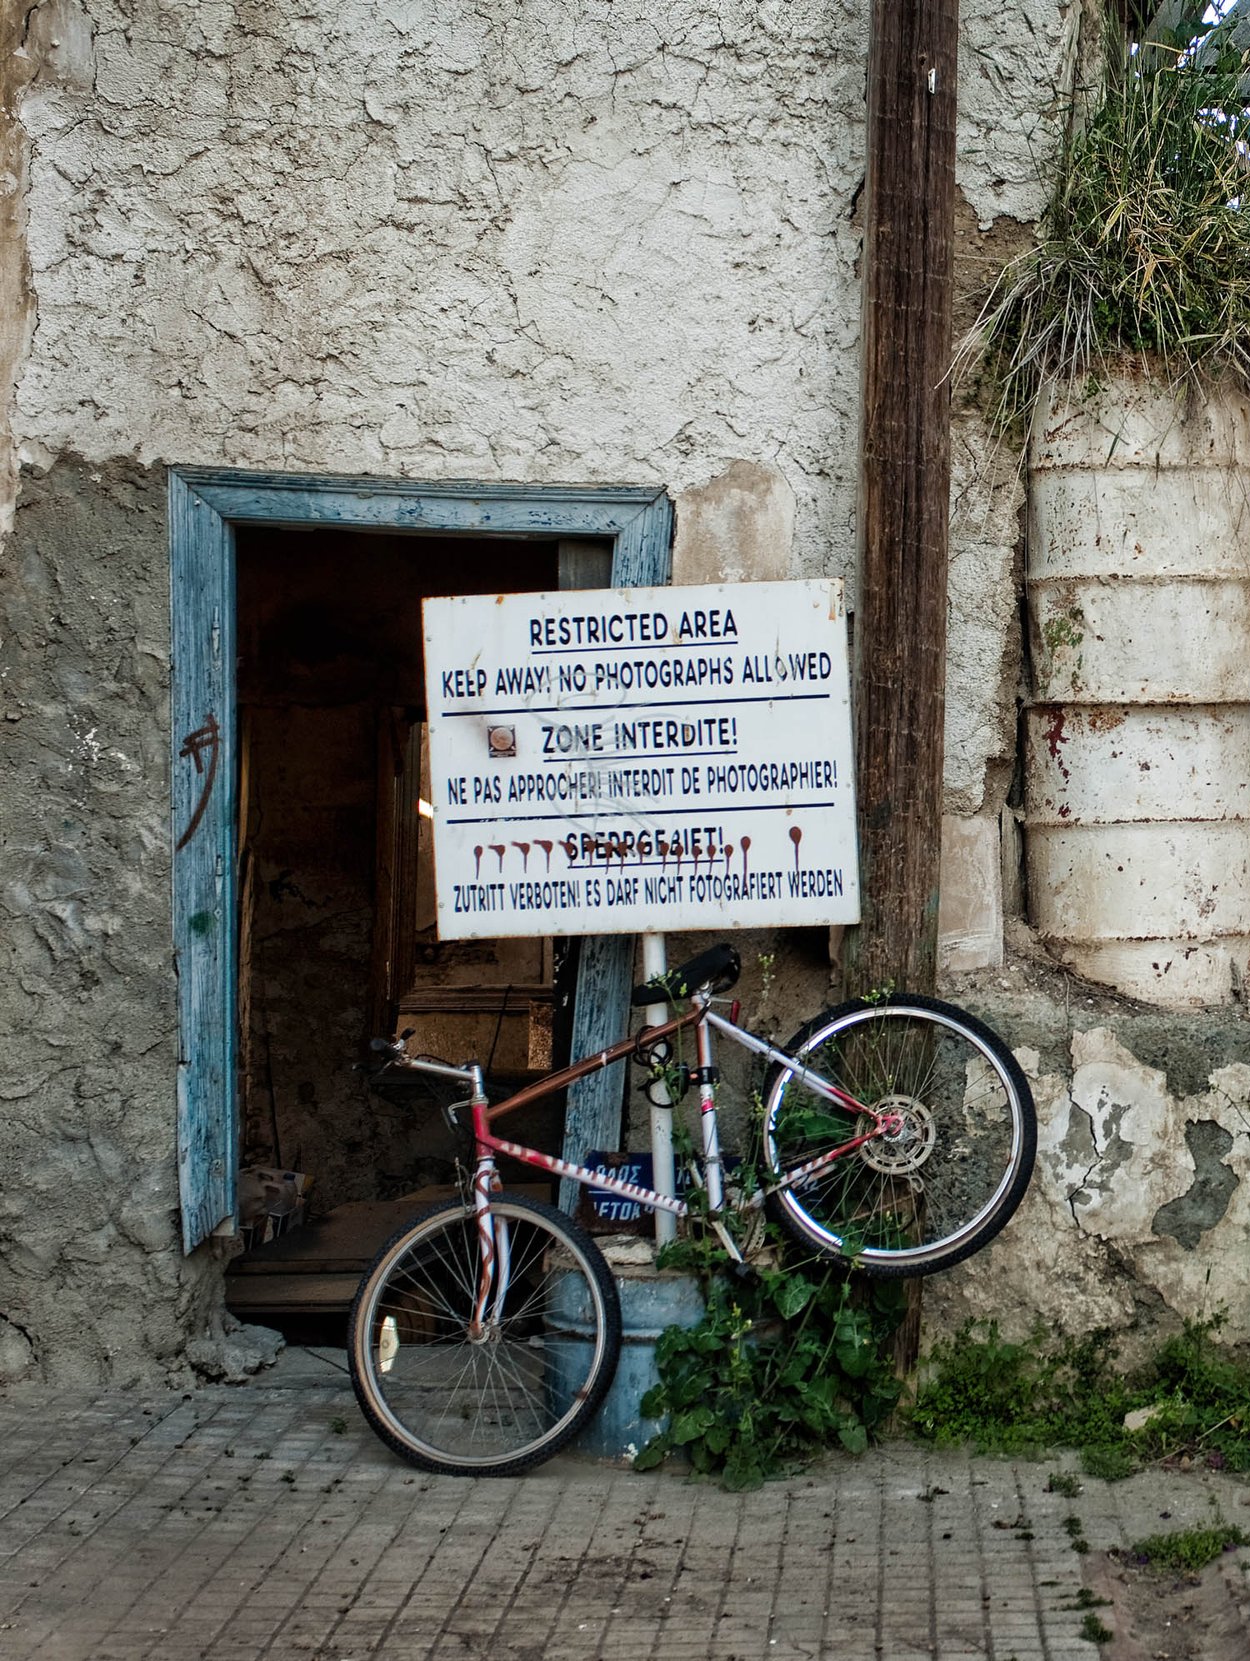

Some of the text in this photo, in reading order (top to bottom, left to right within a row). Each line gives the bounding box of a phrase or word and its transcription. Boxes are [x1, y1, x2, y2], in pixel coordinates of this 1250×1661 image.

[529, 609, 738, 647] RESTRICTED AREA
[442, 652, 832, 698] KEEP AWAY! NO PHOTOGRAPHS ALLOWED
[541, 717, 738, 754] ZONE INTERDITE!
[448, 760, 838, 805] NE PAS APPROCHER! INTERDIT DE PHOTOGRAPHIER!
[565, 826, 725, 862] SPERRGEBIET!
[453, 868, 844, 913] ZUTRITT VERBOTEN! ES DARF NICHT FOTOGRAFIERT WERDEN
